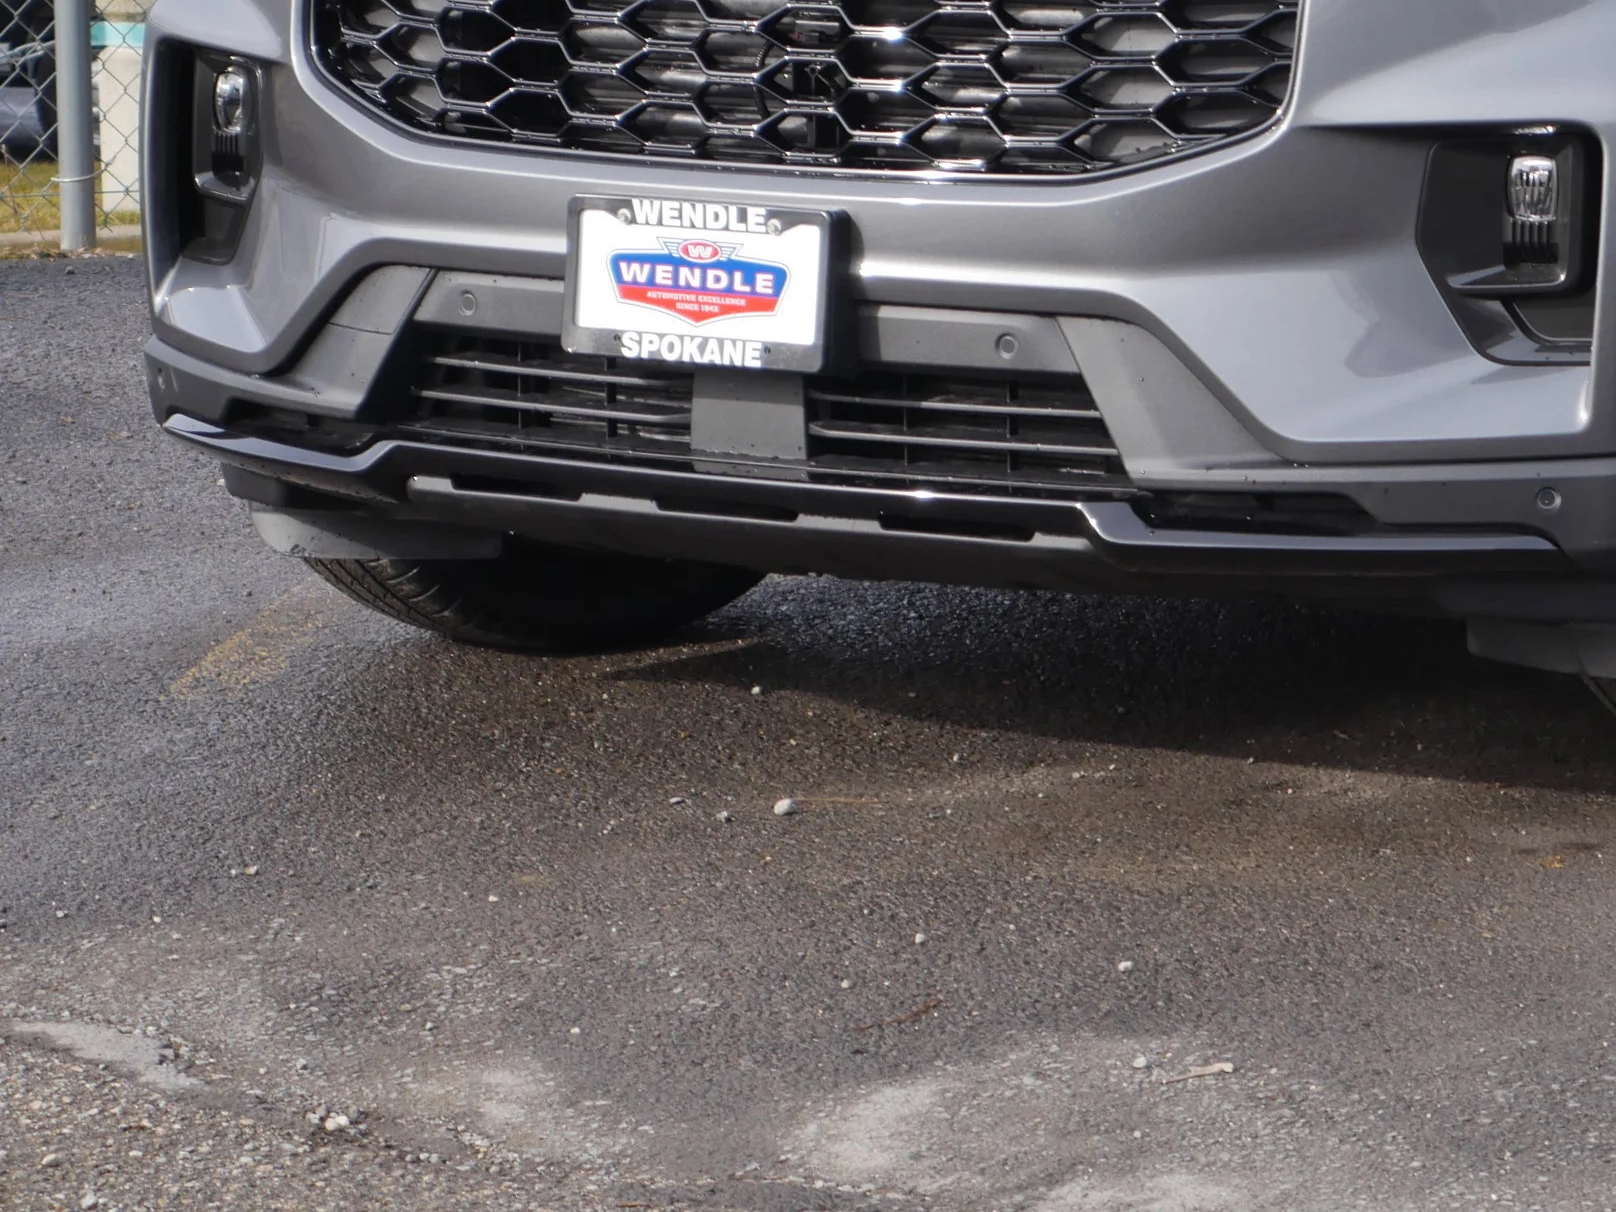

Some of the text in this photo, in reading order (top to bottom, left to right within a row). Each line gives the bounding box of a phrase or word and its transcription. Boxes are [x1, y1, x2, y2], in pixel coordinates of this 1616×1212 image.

[631, 199, 767, 233] WENDLE
[619, 262, 774, 294] WENDLE
[620, 331, 763, 368] SPOKANE
